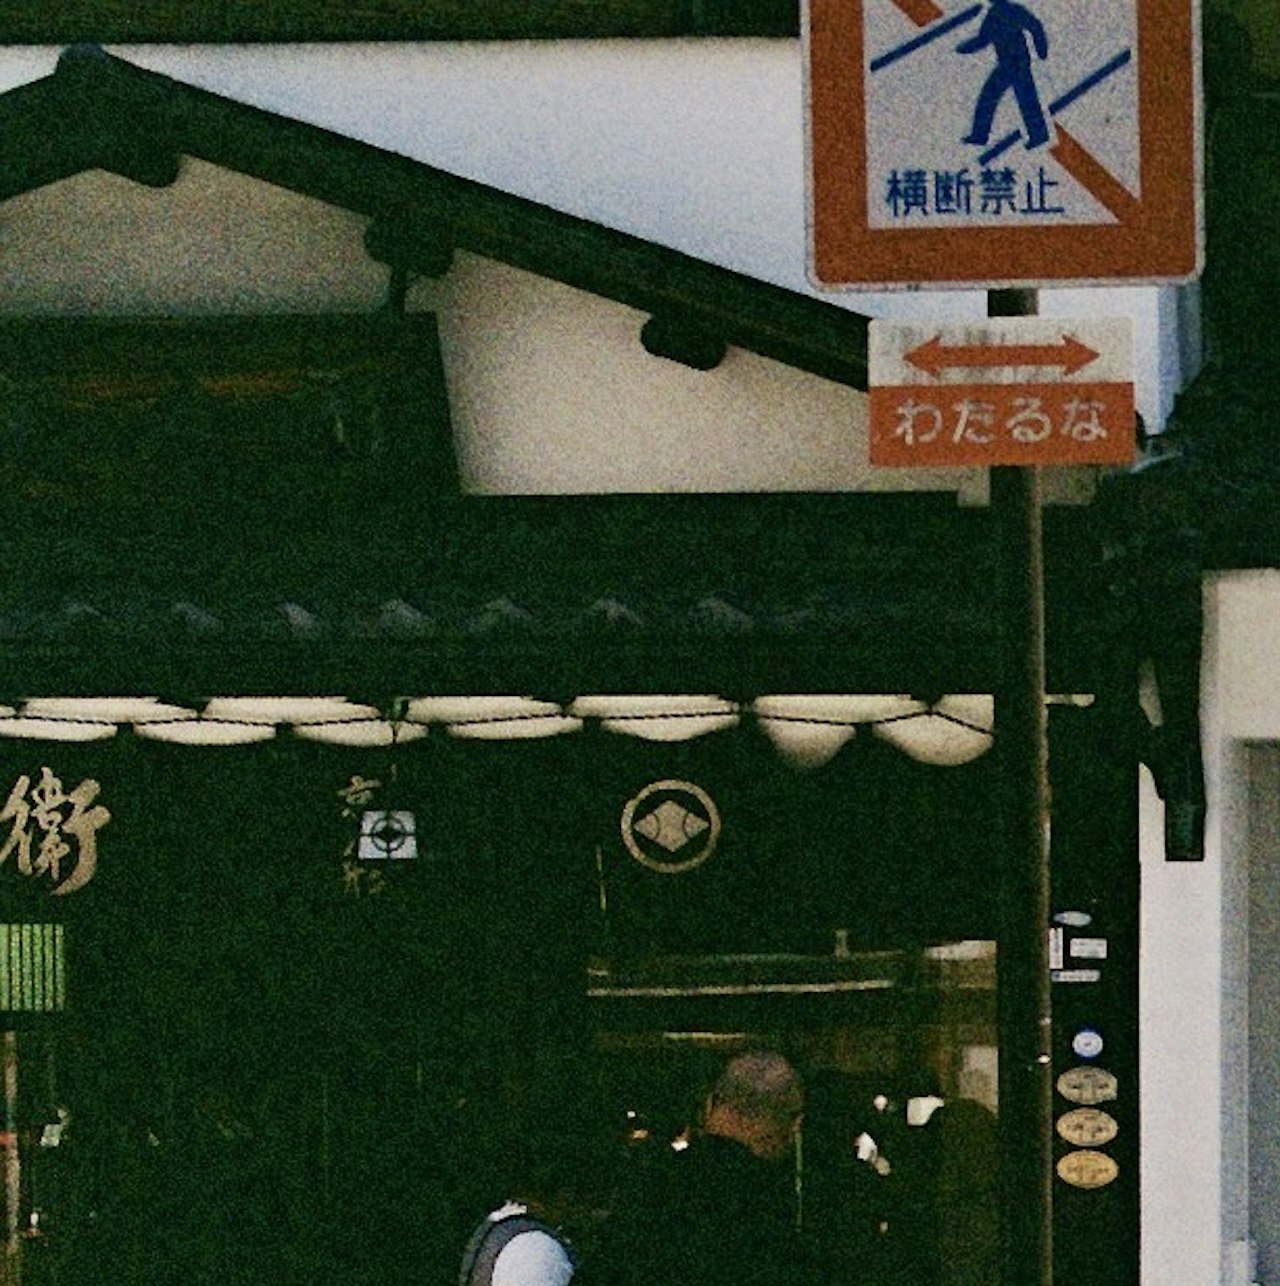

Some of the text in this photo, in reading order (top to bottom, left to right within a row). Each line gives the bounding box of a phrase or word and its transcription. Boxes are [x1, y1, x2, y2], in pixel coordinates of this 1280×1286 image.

[885, 167, 1065, 218] 横断禁止
[894, 397, 1108, 447] わたるな
